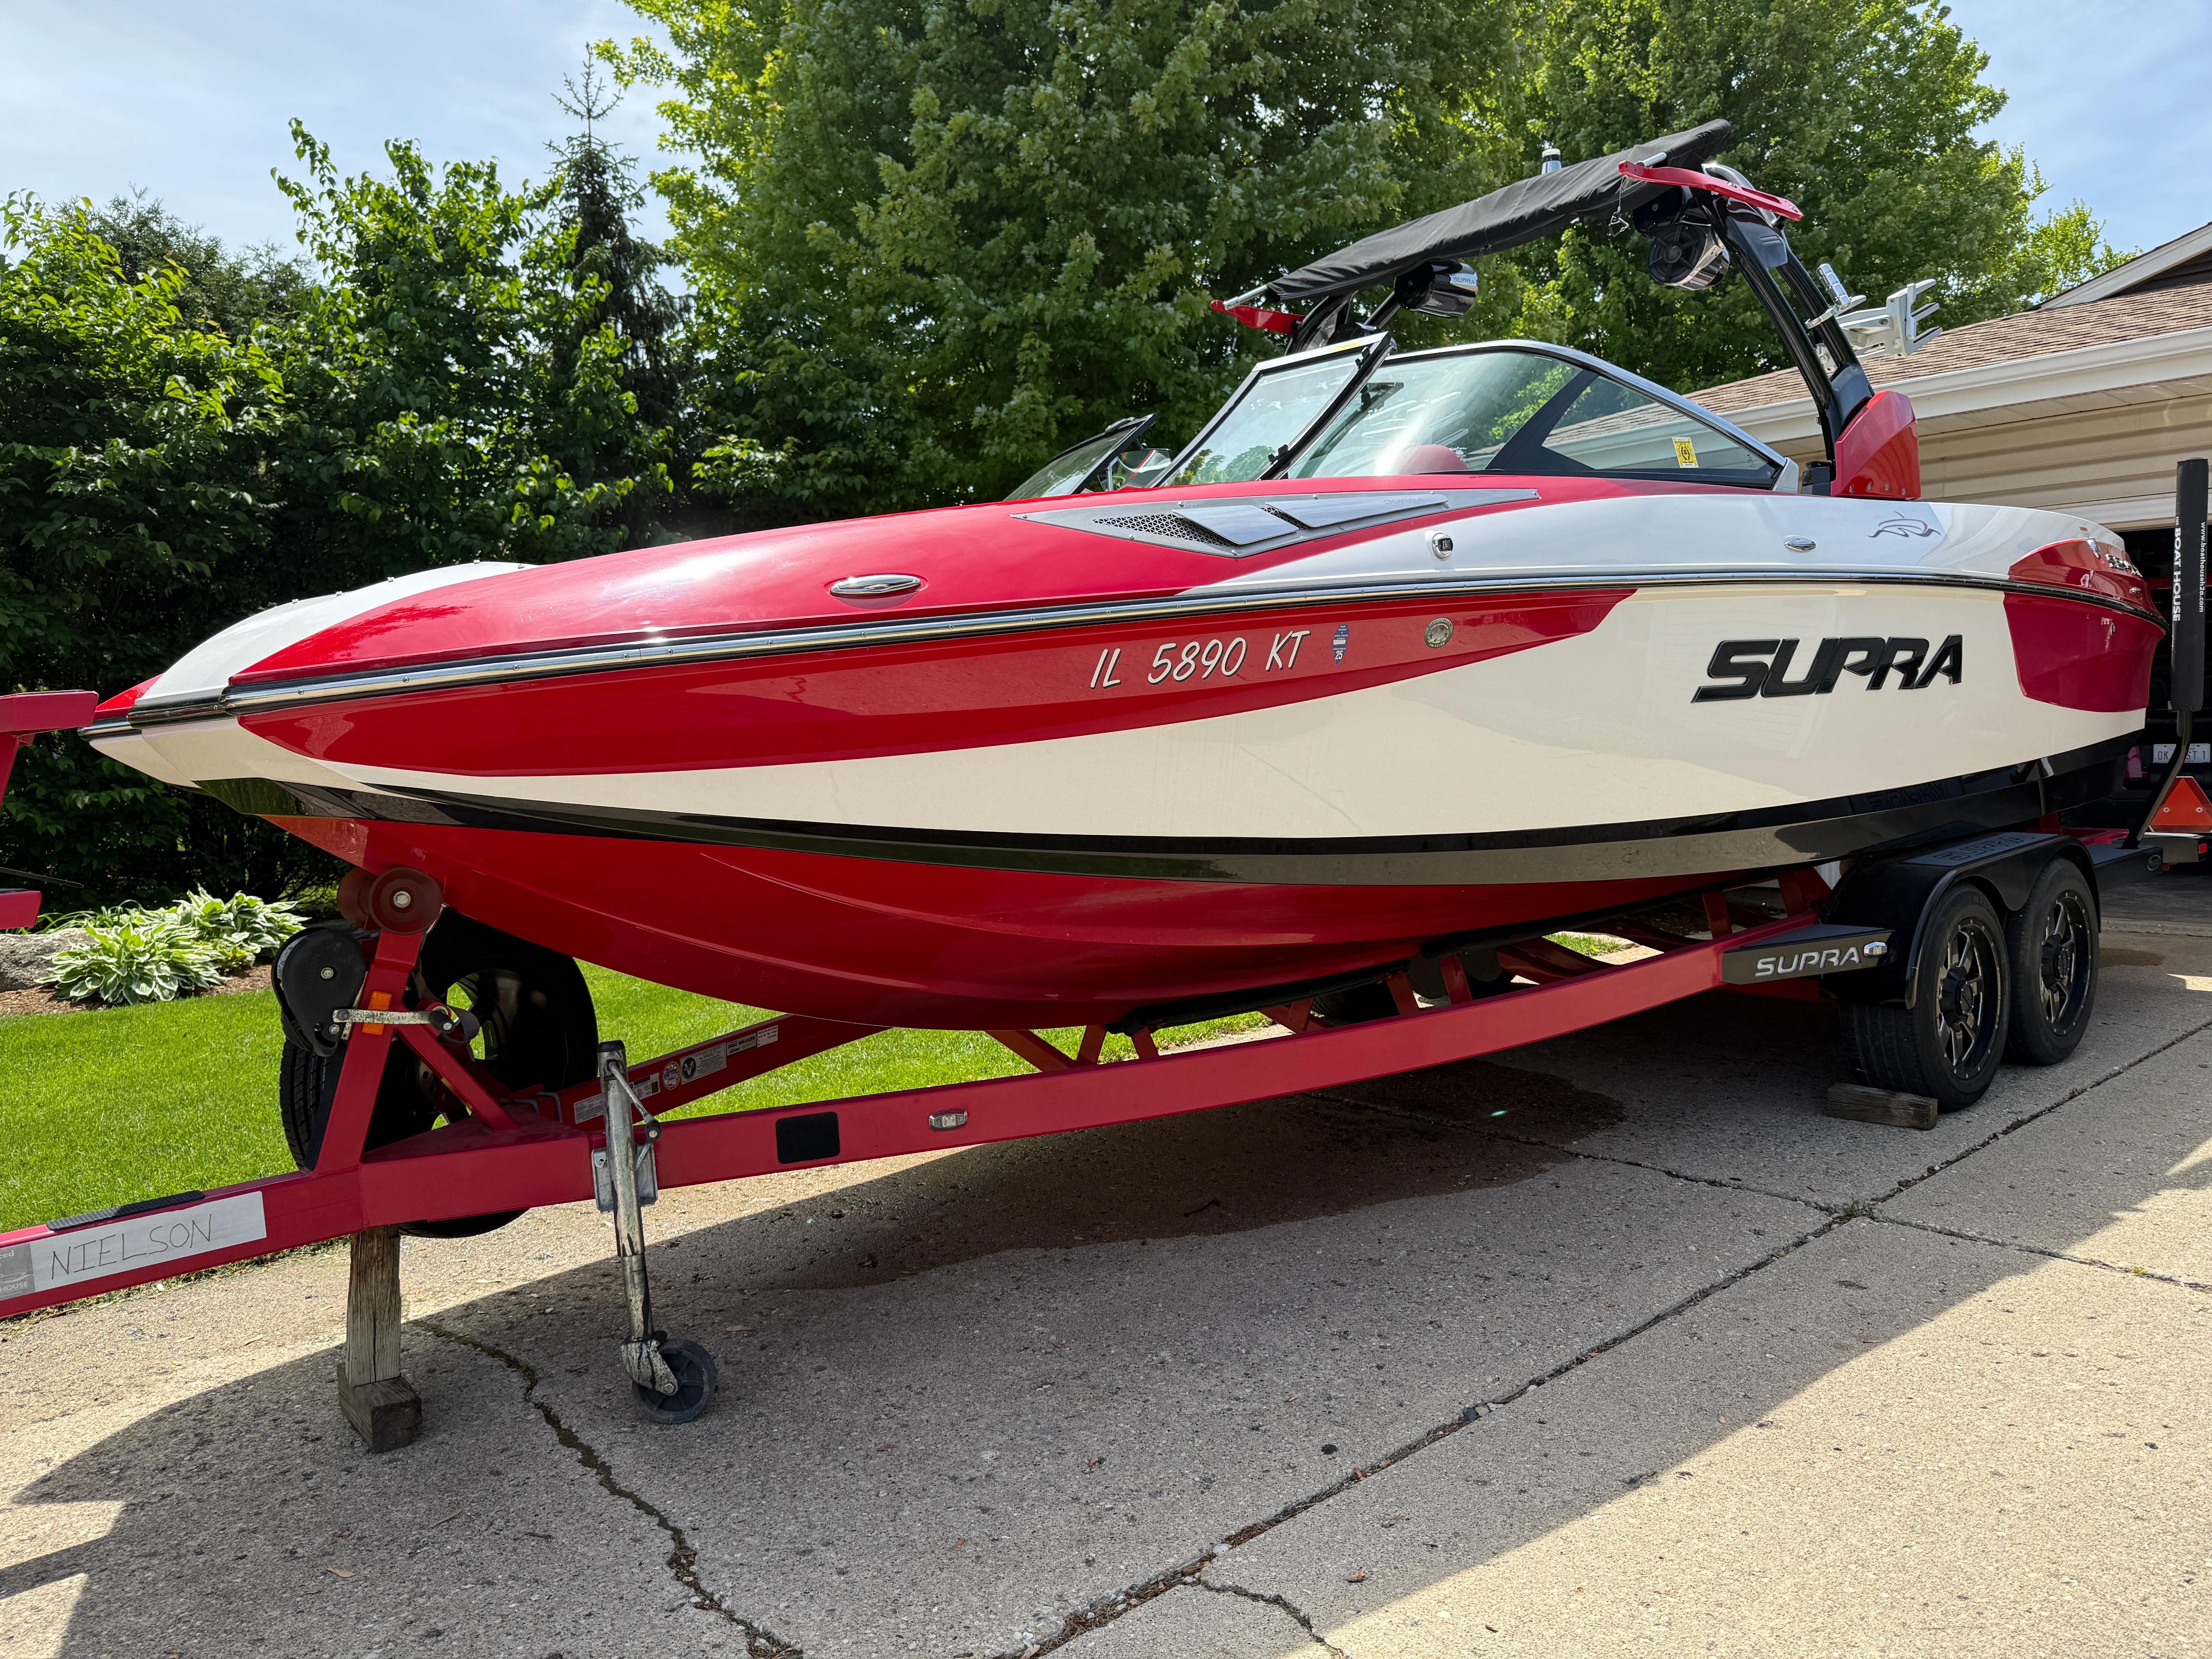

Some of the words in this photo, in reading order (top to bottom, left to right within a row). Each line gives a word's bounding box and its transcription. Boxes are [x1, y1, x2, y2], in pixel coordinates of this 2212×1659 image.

[1453, 277, 1475, 285] SUPRA
[2173, 571, 2181, 621] HOUSE
[1090, 648, 1121, 689] IL
[1147, 637, 1248, 685] 5890
[1265, 630, 1311, 672] KT
[1335, 650, 1343, 660] 25
[1690, 634, 1963, 704] SUPRA
[2158, 751, 2169, 760] OK
[1755, 946, 1861, 977] SUPRA
[738, 1036, 756, 1045] BRAKES
[703, 1050, 717, 1058] VAULT
[51, 1214, 212, 1280] NIELSON
